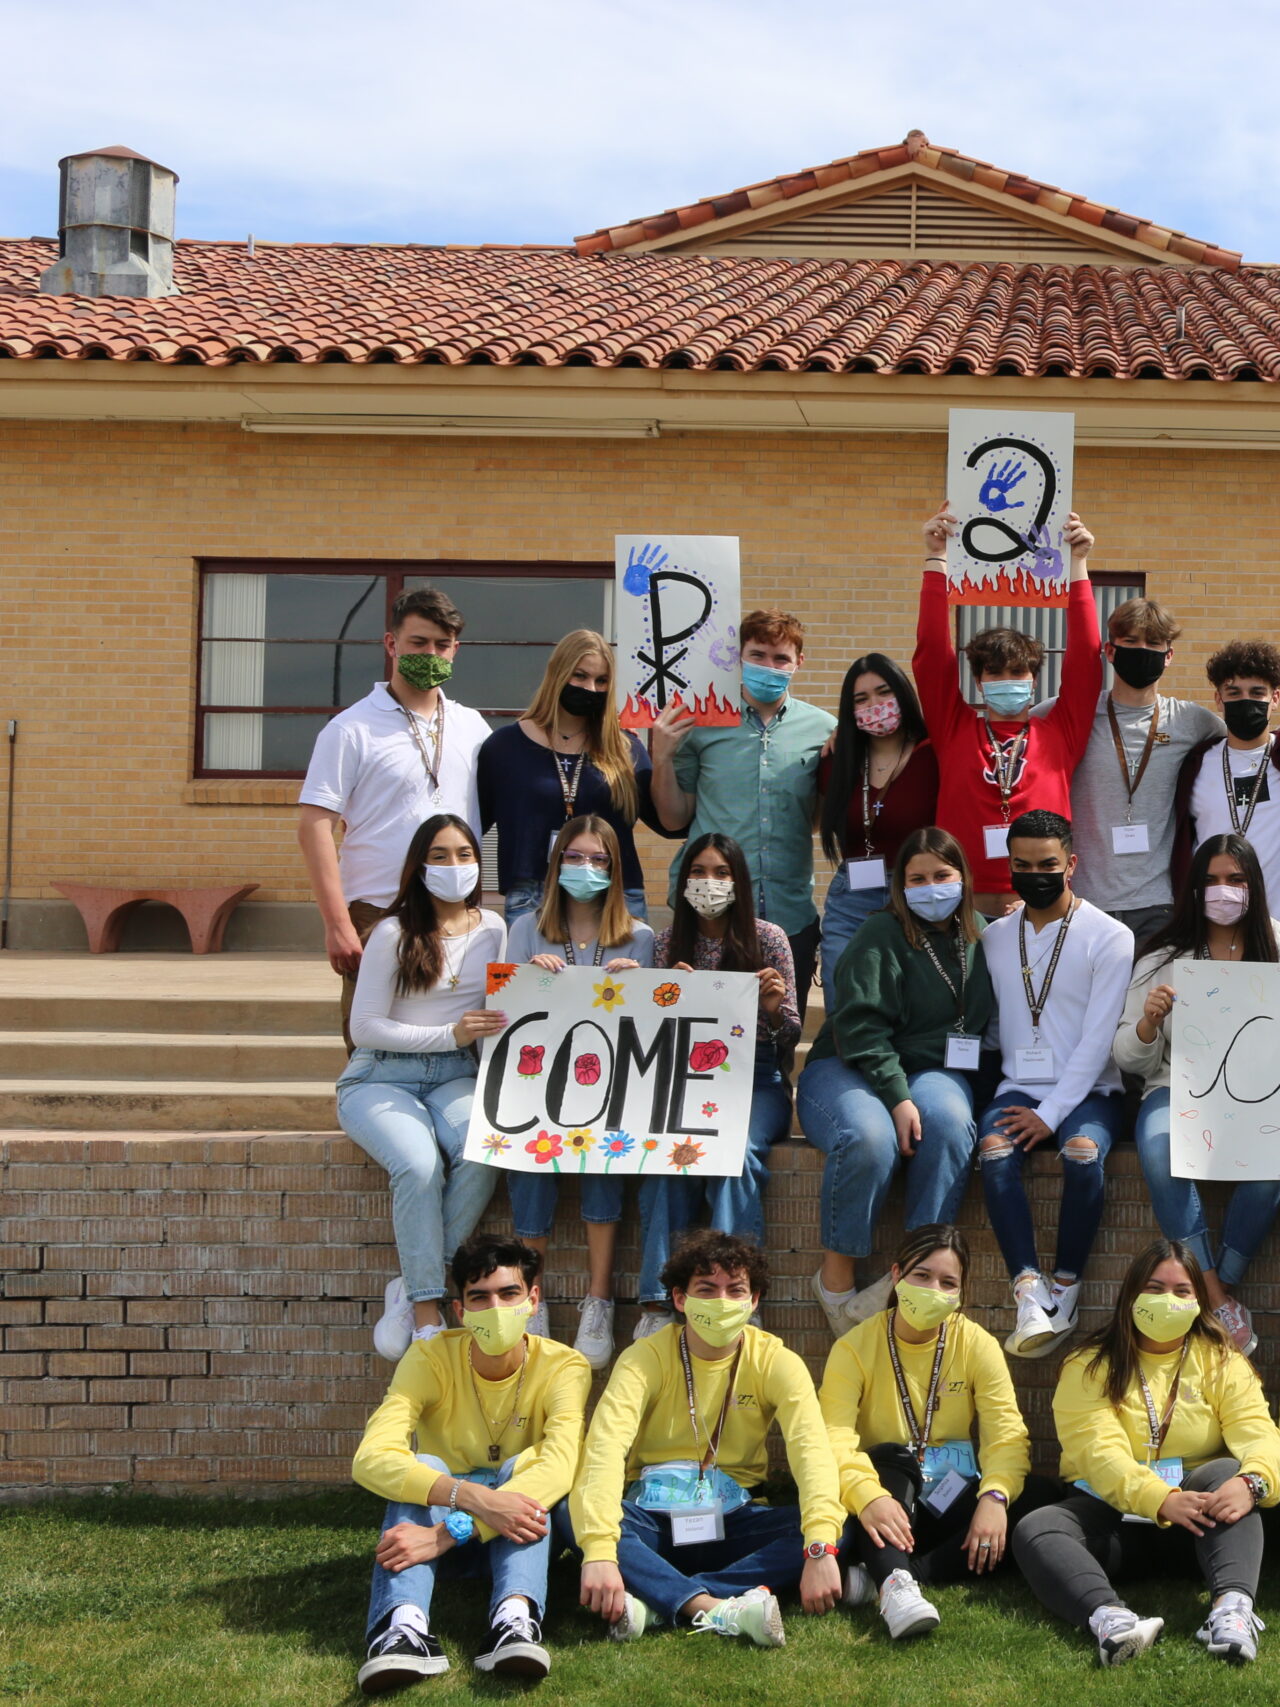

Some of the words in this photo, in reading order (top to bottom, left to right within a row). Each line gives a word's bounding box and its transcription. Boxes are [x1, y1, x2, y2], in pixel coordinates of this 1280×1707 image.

[960, 437, 1057, 563] 2
[483, 1011, 719, 1137] COME
[1143, 1390, 1159, 1437] CARMELITES
